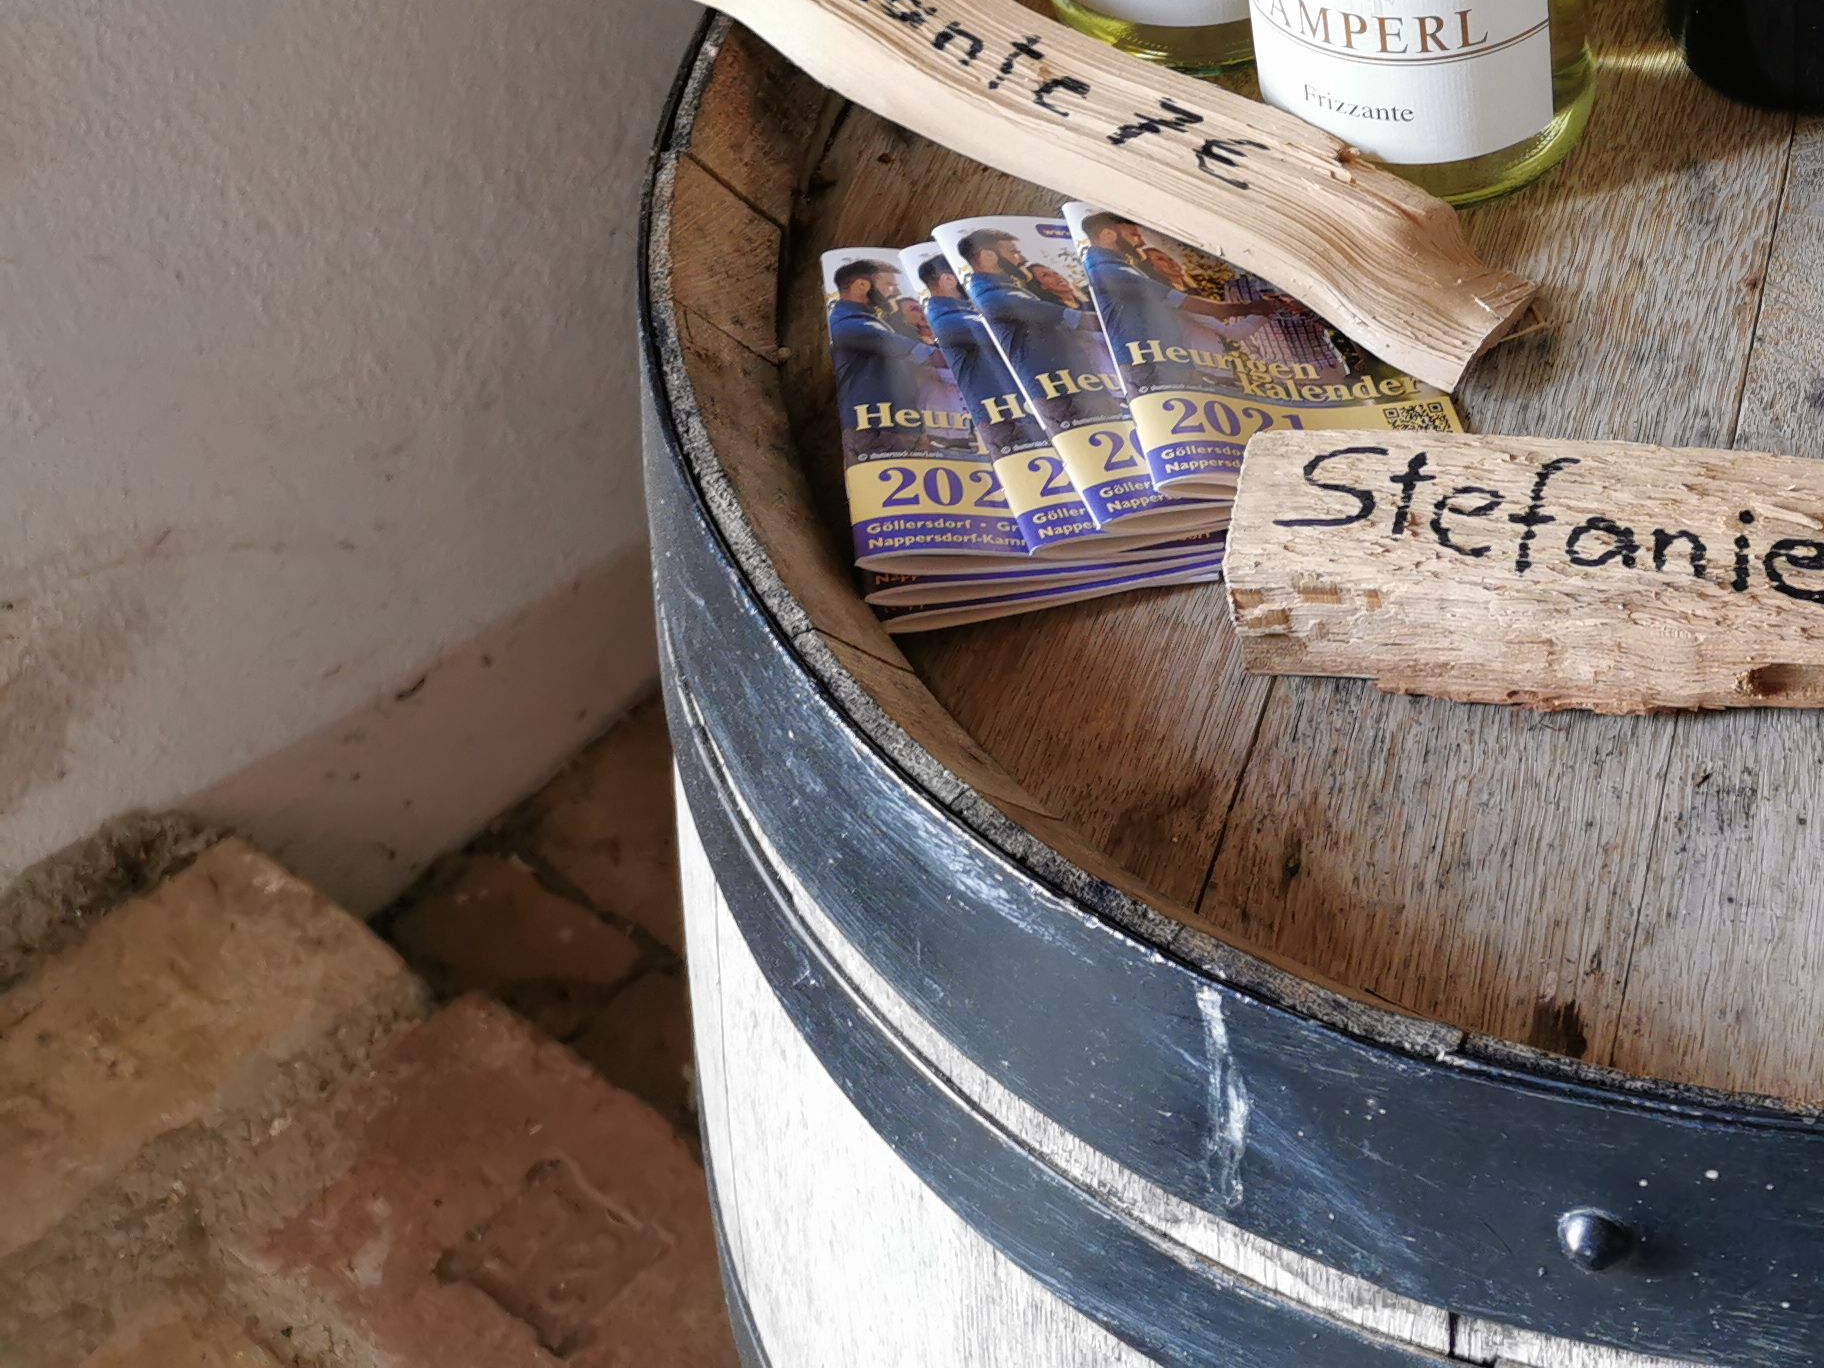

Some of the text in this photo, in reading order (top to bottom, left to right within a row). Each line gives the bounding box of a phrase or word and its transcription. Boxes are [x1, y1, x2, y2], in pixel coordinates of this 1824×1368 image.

[1303, 82, 1415, 123] Frizzante
[1126, 339, 1321, 383] Heurigen
[1240, 372, 1420, 403] kalender
[854, 400, 973, 432] Heur
[1161, 444, 1244, 460] Göllersdo
[878, 467, 1011, 509] 202
[866, 518, 971, 535] Göllersdorf
